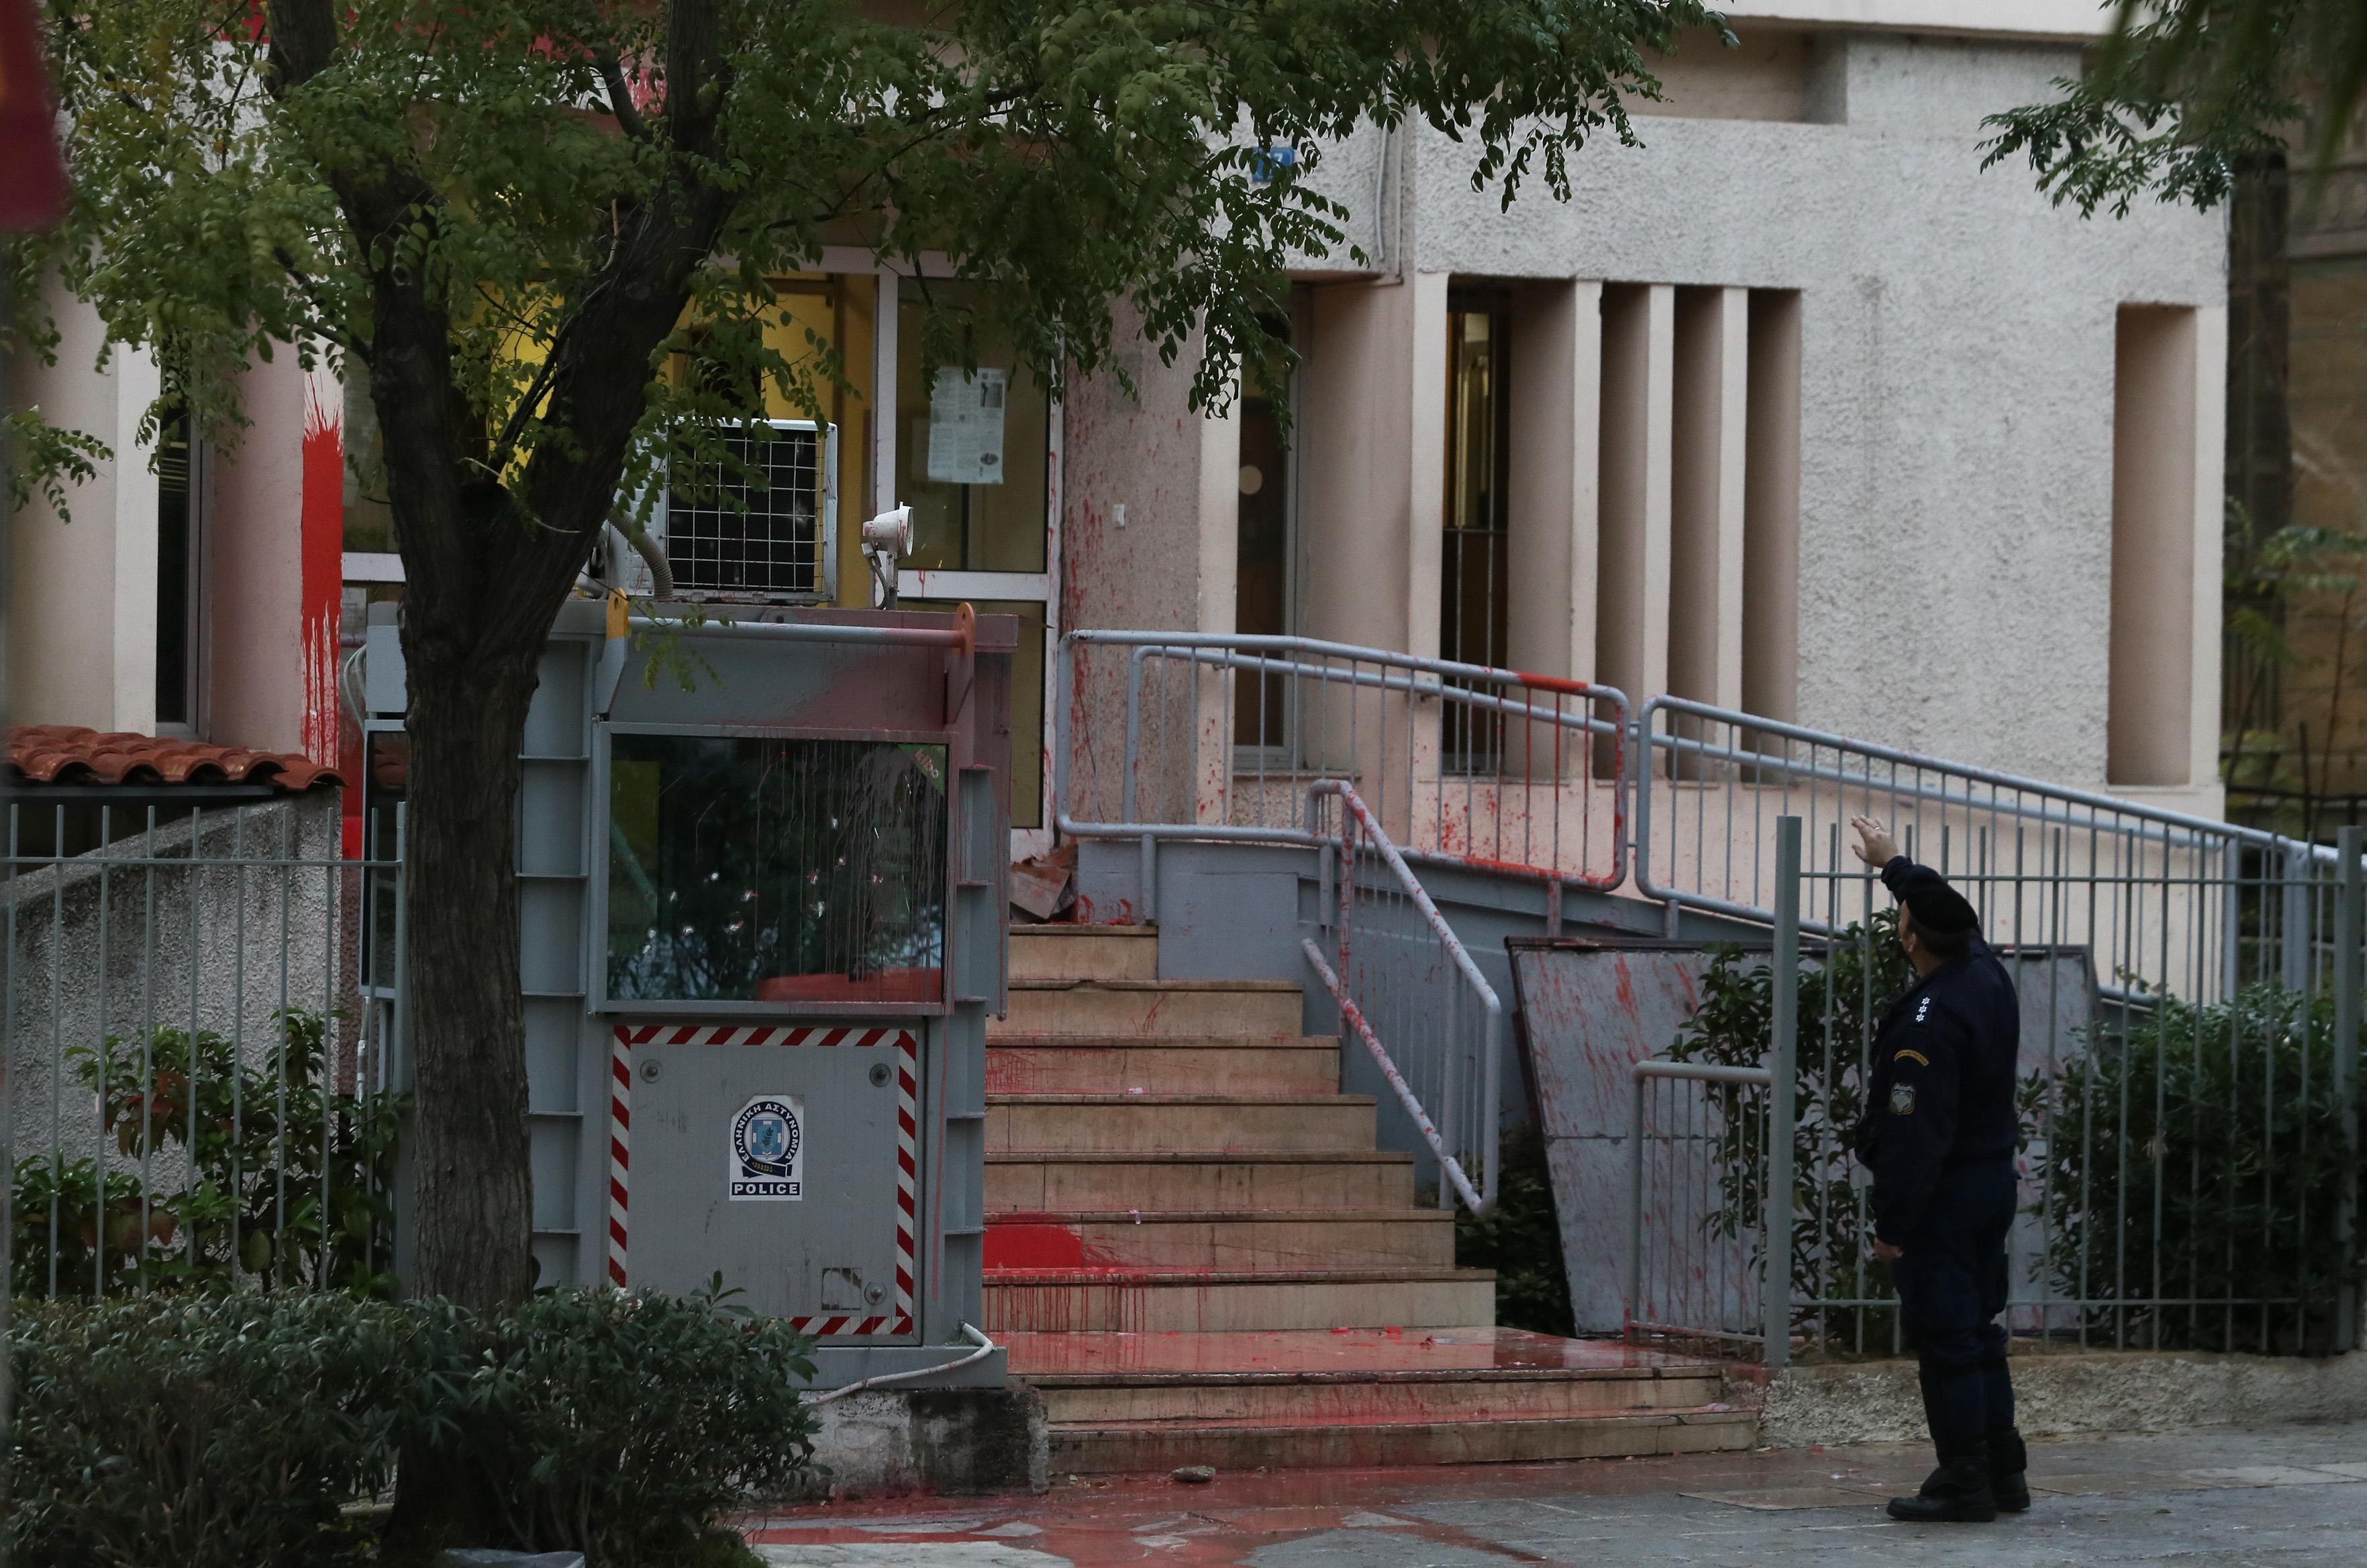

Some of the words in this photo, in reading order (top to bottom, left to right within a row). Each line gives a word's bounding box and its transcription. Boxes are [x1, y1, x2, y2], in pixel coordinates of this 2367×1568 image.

[736, 1104, 762, 1162] ΕΛΛΗΝΙΚΗ
[765, 1102, 799, 1159] ΑΣΤΥΝΟΜΙΑ
[734, 1184, 798, 1194] POLICE
